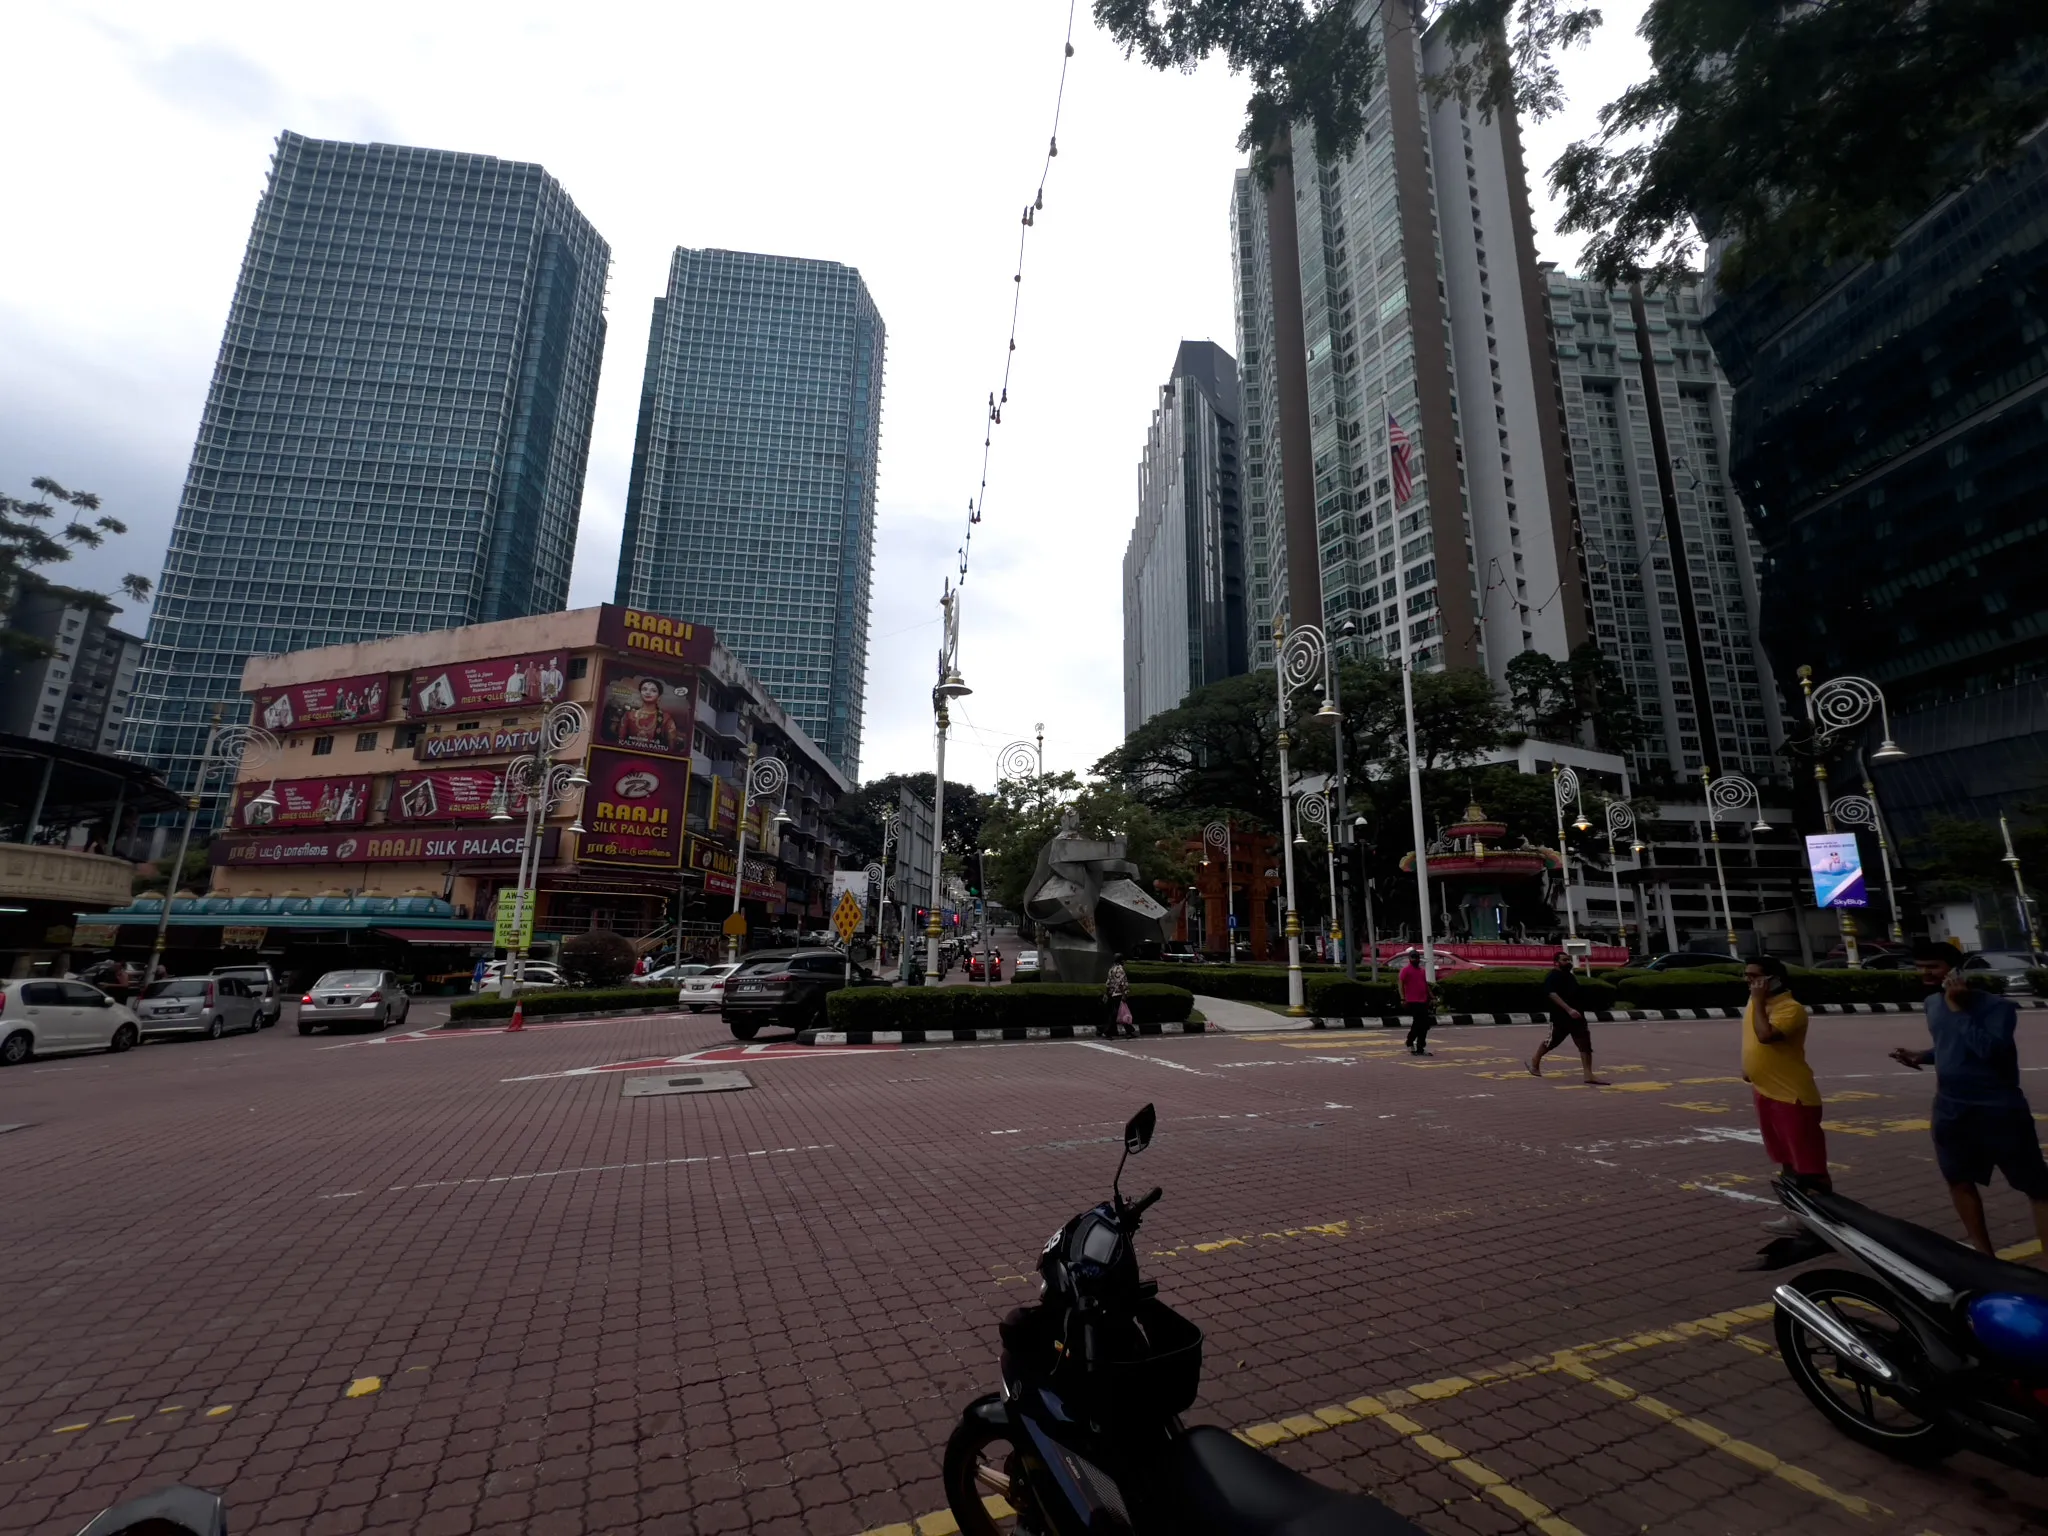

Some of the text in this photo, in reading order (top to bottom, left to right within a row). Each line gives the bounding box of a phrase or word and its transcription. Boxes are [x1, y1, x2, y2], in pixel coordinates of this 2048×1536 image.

[624, 610, 694, 641] RAAJI
[627, 631, 684, 657] MALL
[427, 731, 540, 756] KALYANA PATTU
[596, 801, 669, 824] RAAJI
[592, 821, 668, 838] SILK PALACE
[228, 841, 328, 860] ராஜி பட்டு மாளிகை
[367, 838, 525, 857] RAAJI SILK PALACE
[586, 842, 619, 855] ராஜி
[505, 892, 529, 900] AWS
